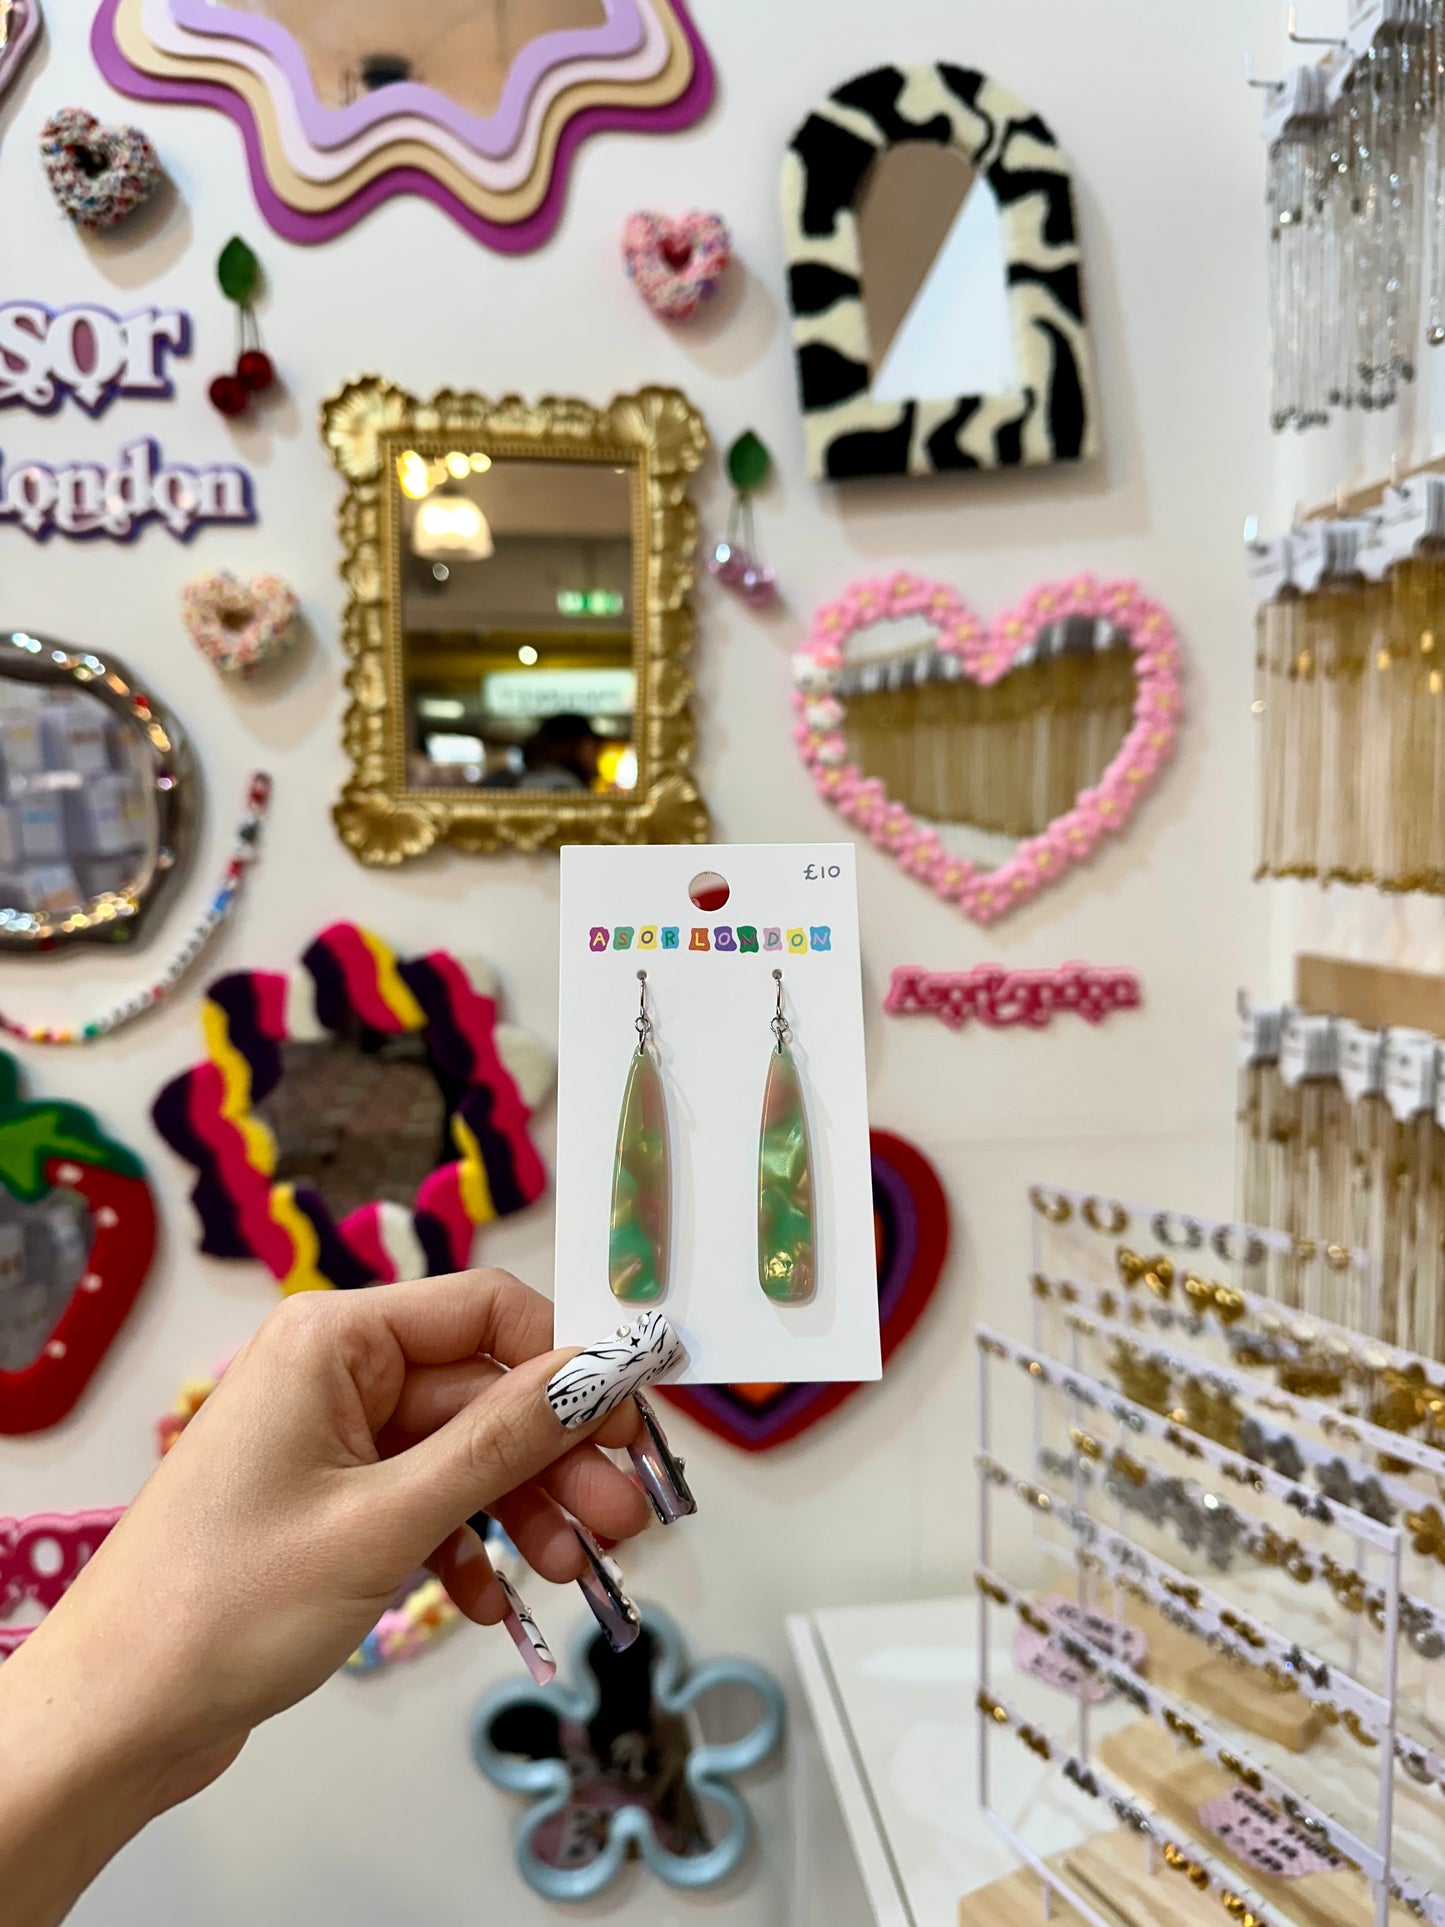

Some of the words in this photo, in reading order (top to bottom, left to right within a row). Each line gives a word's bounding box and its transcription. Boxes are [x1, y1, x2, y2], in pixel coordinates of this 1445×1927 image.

[0, 434, 259, 543] ondon
[803, 863, 841, 881] £10
[590, 927, 678, 951] ASOR
[689, 926, 830, 953] LONDON
